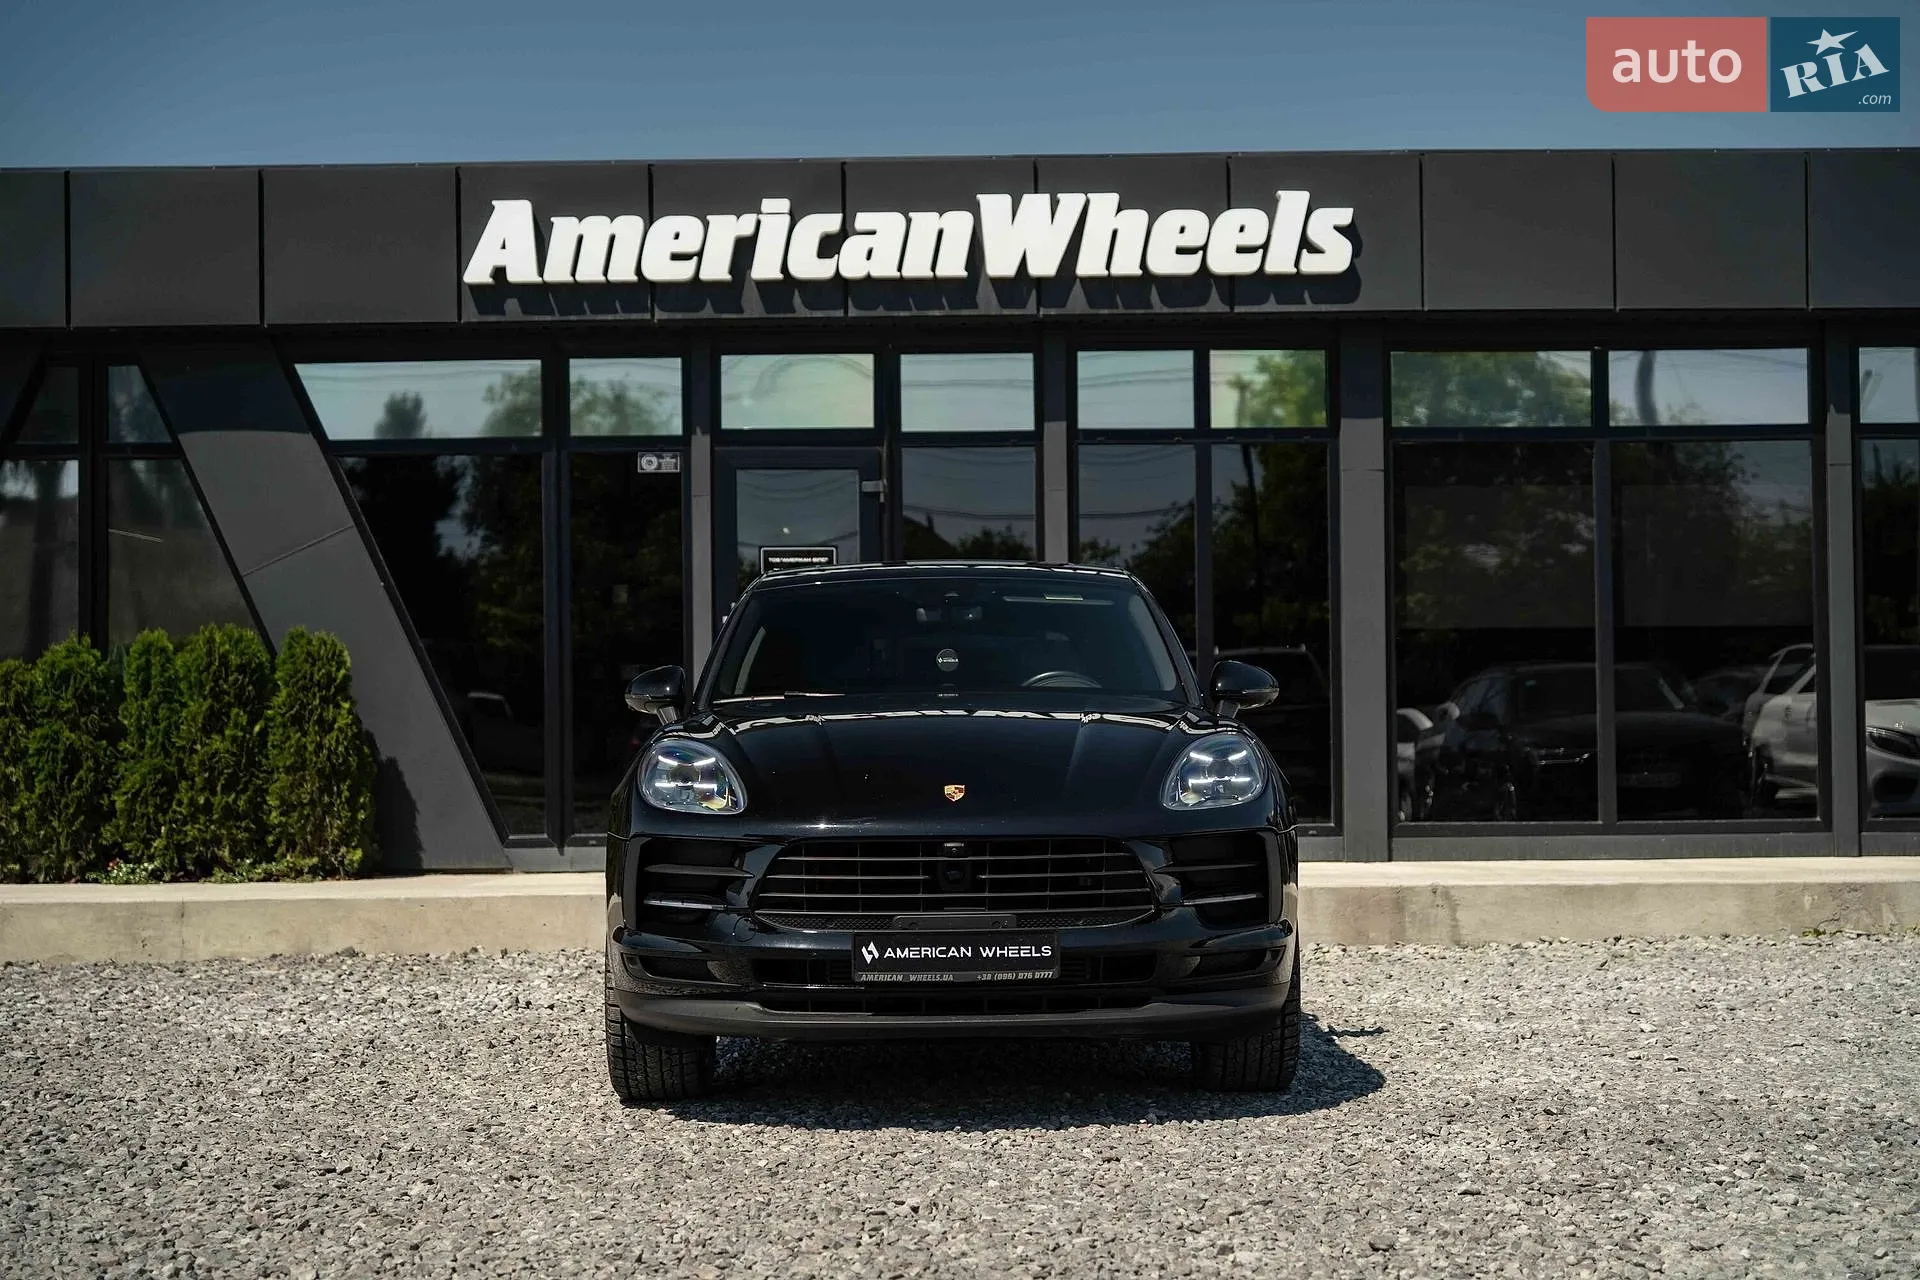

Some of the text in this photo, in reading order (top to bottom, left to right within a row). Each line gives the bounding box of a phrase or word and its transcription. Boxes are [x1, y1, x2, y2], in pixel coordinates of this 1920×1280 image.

[463, 190, 1354, 283] AmericanWheels
[883, 945, 1052, 959] AMERICAN WHEELS
[860, 974, 954, 982] AMERICAN WHEELS.UA
